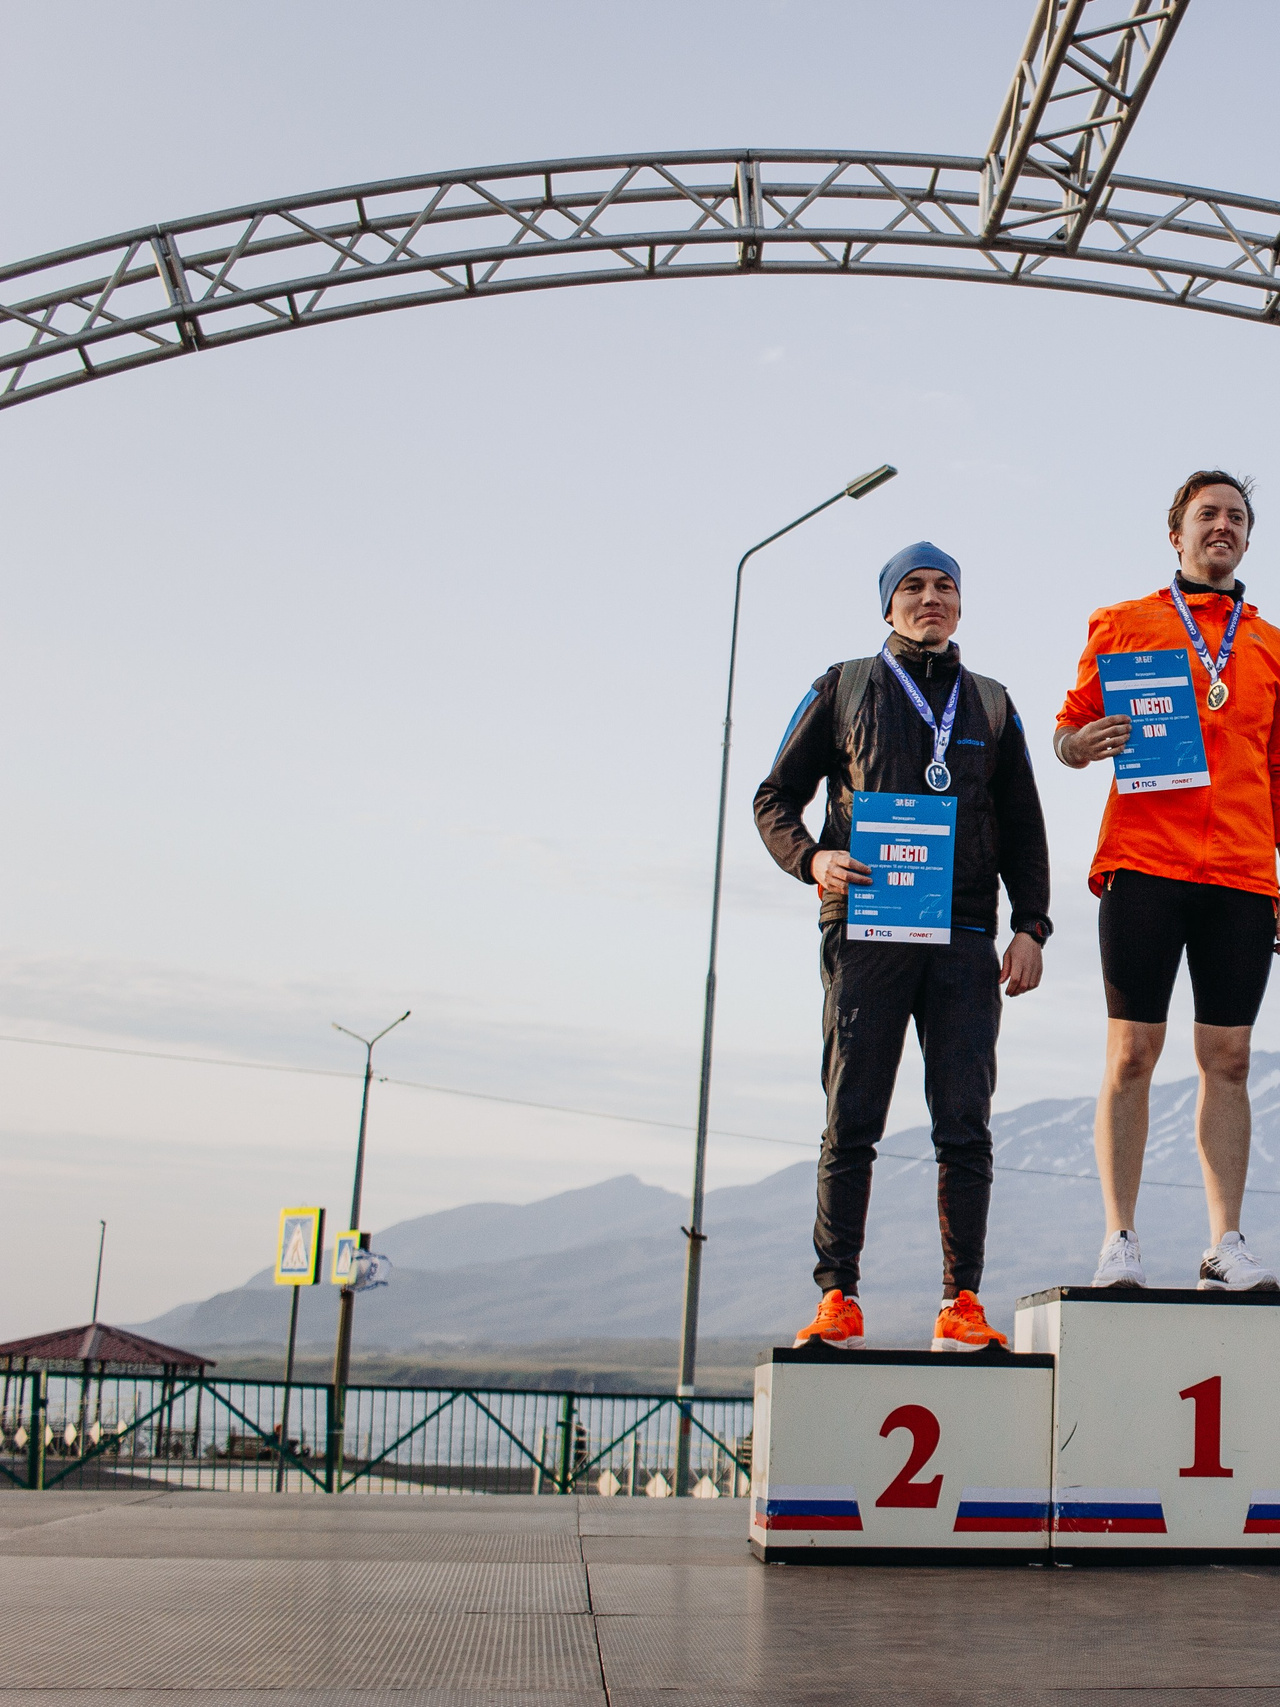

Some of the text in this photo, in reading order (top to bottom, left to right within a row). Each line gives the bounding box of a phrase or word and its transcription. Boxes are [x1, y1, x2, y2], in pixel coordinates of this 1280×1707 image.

[1136, 696, 1173, 715] МЕСТО
[1143, 724, 1167, 738] 10 КМ
[890, 845, 928, 863] МЕСТО
[888, 871, 915, 886] 10 КМ
[1179, 1375, 1234, 1478] 1
[875, 1404, 944, 1508] 2
